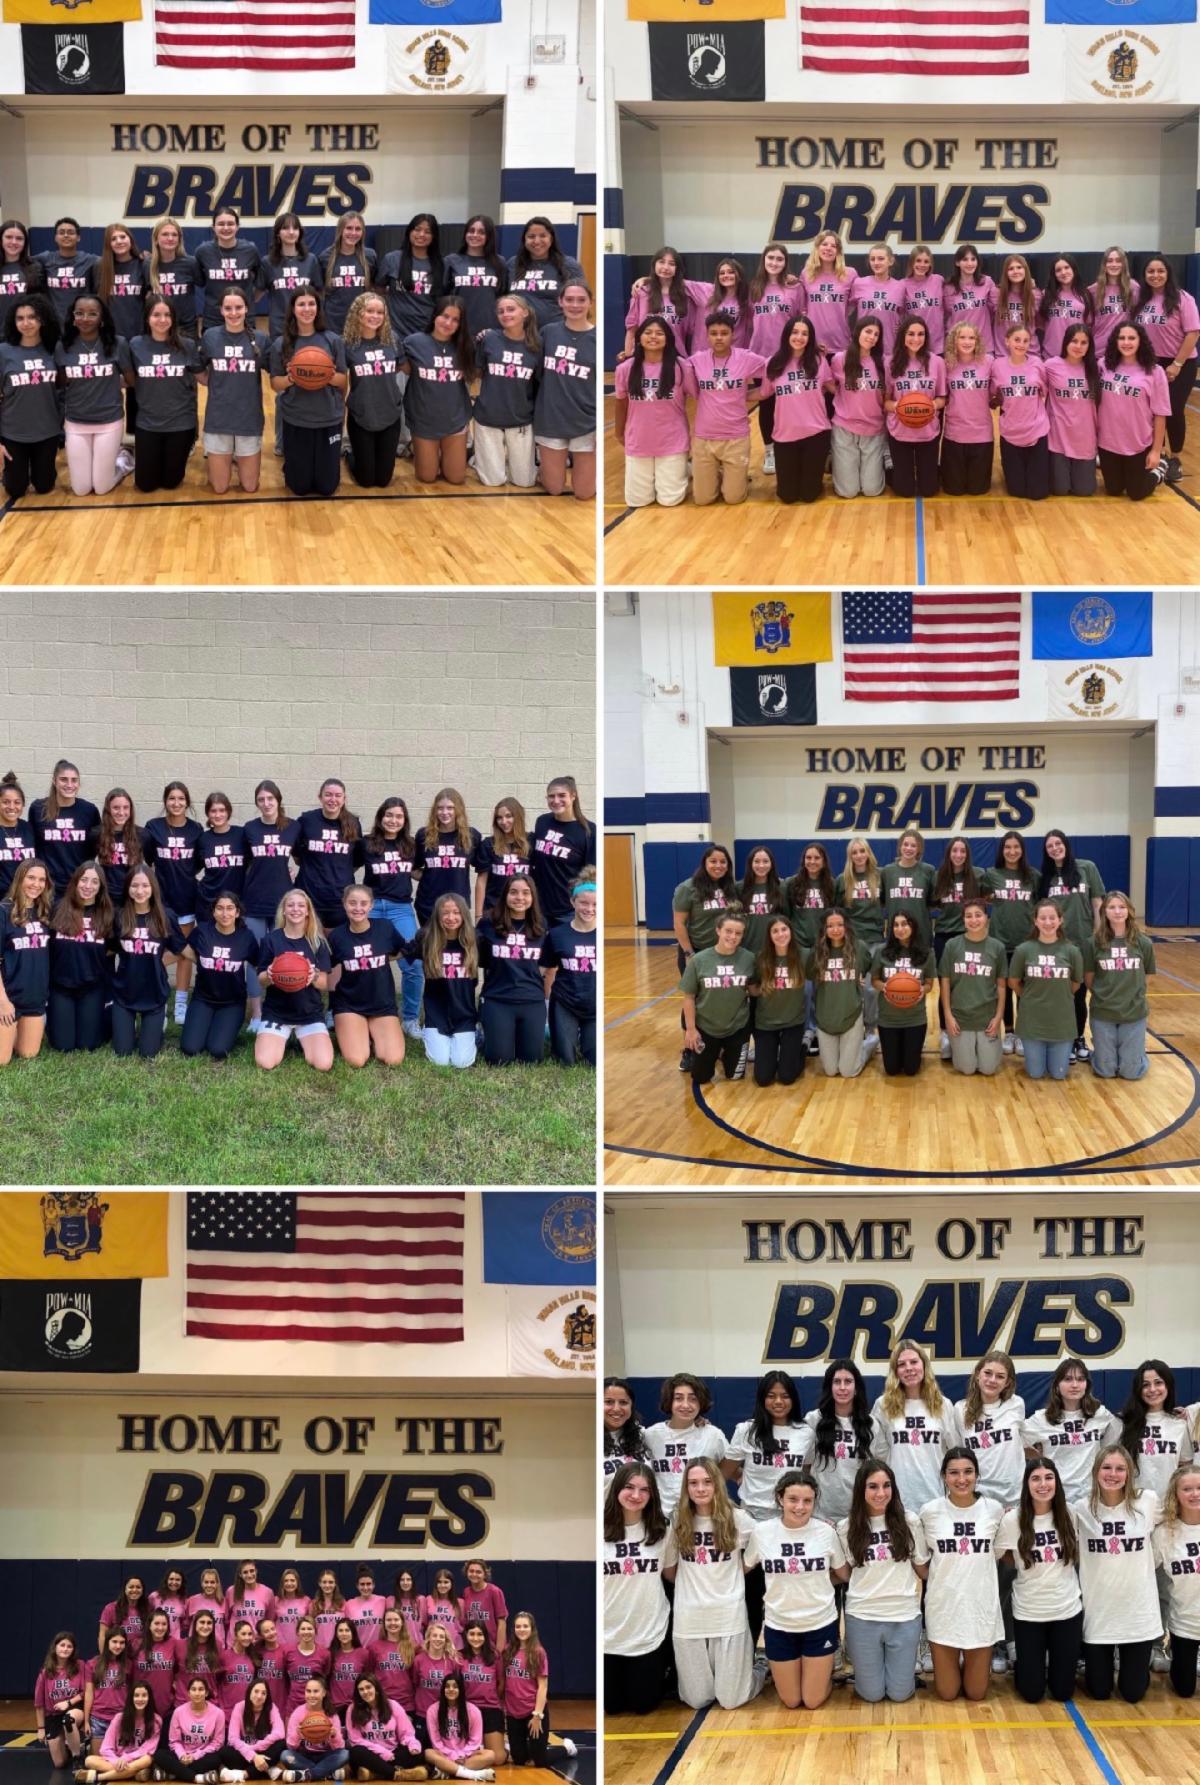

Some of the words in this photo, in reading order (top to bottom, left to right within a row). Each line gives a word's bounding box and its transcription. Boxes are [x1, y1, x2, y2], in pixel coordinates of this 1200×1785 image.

[111, 123, 226, 152] HOME
[241, 123, 291, 152] OF
[306, 123, 380, 151] THE
[755, 136, 885, 170] HOME
[904, 138, 960, 170] OF
[975, 138, 1059, 169] THE
[123, 163, 374, 219] BRAVES
[770, 182, 1051, 244] BRAVES
[221, 259, 236, 268] BE
[57, 267, 74, 277] BE
[209, 268, 248, 280] BRAVE
[283, 267, 299, 277] BE
[340, 266, 355, 276] BE
[468, 267, 485, 276] BE
[525, 270, 544, 280] BE
[48, 277, 86, 288] BRAVE
[455, 275, 498, 287] BRAVE
[767, 295, 781, 303] BE
[906, 298, 939, 309] BRAVE
[756, 304, 791, 314] BRAVE
[225, 346, 243, 357] BE
[365, 350, 384, 362] BE
[502, 351, 523, 363] BE
[555, 345, 578, 360] BE
[24, 359, 45, 370] BE
[79, 353, 98, 365] BE
[152, 354, 170, 365] BE
[212, 357, 255, 373] BRAVE
[433, 356, 453, 368] BE
[66, 364, 113, 378] BRAVE
[138, 364, 184, 377] BRAVE
[297, 367, 326, 378] Wilson
[488, 363, 533, 379] BRAVE
[713, 369, 729, 377] BE
[788, 370, 803, 380] BE
[962, 369, 976, 378] BE
[1011, 376, 1025, 384] BE
[1068, 379, 1085, 387] BE
[1113, 374, 1130, 383] BE
[700, 379, 743, 391] BRAVE
[776, 380, 818, 396] BRAVE
[896, 380, 934, 391] BRAVE
[1100, 379, 1141, 398] BRAVE
[905, 406, 929, 414] Wilson
[805, 747, 907, 773] HOME
[921, 746, 965, 772] OF
[978, 745, 1047, 770] THE
[815, 779, 1040, 832] BRAVES
[56, 819, 74, 829] BE
[44, 830, 86, 842] BRAVE
[264, 835, 280, 843] BE
[322, 830, 338, 840] BE
[545, 830, 564, 843] BE
[5, 837, 22, 848] BE
[168, 837, 185, 847] BE
[309, 840, 349, 854] BRAVE
[157, 848, 193, 859] BRAVE
[215, 845, 231, 855] BE
[252, 844, 292, 857] BRAVE
[438, 845, 455, 856] BE
[535, 840, 571, 859] BRAVE
[204, 855, 243, 868] BRAVE
[384, 851, 401, 861] BE
[425, 856, 466, 868] BRAVE
[503, 854, 519, 863] BE
[372, 860, 412, 874] BRAVE
[899, 877, 913, 887] BE
[1005, 879, 1021, 889] BE
[752, 893, 766, 902] BE
[890, 886, 924, 898] BRAVE
[26, 922, 43, 934] BE
[506, 934, 526, 946] BE
[212, 946, 231, 958] BE
[354, 944, 372, 958] BE
[492, 944, 541, 959] BRAVE
[575, 945, 596, 958] BE
[965, 951, 981, 962] BE
[1111, 947, 1127, 958] BE
[200, 956, 242, 972] BRAVE
[343, 955, 386, 971] BRAVE
[442, 953, 461, 964] BE
[827, 958, 843, 969] BE
[1038, 954, 1055, 966] BE
[1099, 958, 1141, 971] BRAVE
[717, 965, 735, 975] BE
[954, 962, 992, 977] BRAVE
[1027, 966, 1069, 978] BRAVE
[704, 975, 747, 988] BRAVE
[742, 1218, 915, 1263] HOME
[936, 1217, 1011, 1262] OF
[1033, 1215, 1145, 1259] THE
[45, 1293, 68, 1319] POW
[74, 1293, 92, 1319] MIA
[762, 1273, 1134, 1364] BRAVES
[905, 1416, 925, 1429] BE
[975, 1419, 994, 1432] BE
[1063, 1420, 1084, 1432] BE
[116, 1414, 281, 1454] HOME
[303, 1415, 375, 1455] OF
[396, 1416, 504, 1455] THE
[835, 1432, 852, 1442] BE
[893, 1429, 940, 1445] BRAVE
[1049, 1429, 1100, 1446] BRAVE
[1143, 1426, 1162, 1438] BE
[965, 1428, 1013, 1449] BRAVE
[665, 1444, 687, 1457] BE
[752, 1452, 803, 1467] BRAVE
[126, 1468, 495, 1549] BRAVES
[953, 1522, 975, 1536] BE
[1102, 1521, 1126, 1535] BE
[694, 1532, 714, 1546] BE
[871, 1531, 890, 1543] BE
[1035, 1531, 1058, 1546] BE
[616, 1542, 641, 1558] BE
[781, 1543, 805, 1557] BE
[937, 1537, 990, 1555] BRAVE
[1088, 1536, 1145, 1554] BRAVE
[604, 1558, 659, 1575] BRAVE
[764, 1557, 825, 1574] BRAVE
[244, 1600, 256, 1608] BE
[55, 1679, 70, 1689] BE
[191, 1725, 204, 1734] BE
[372, 1721, 384, 1730] BE
